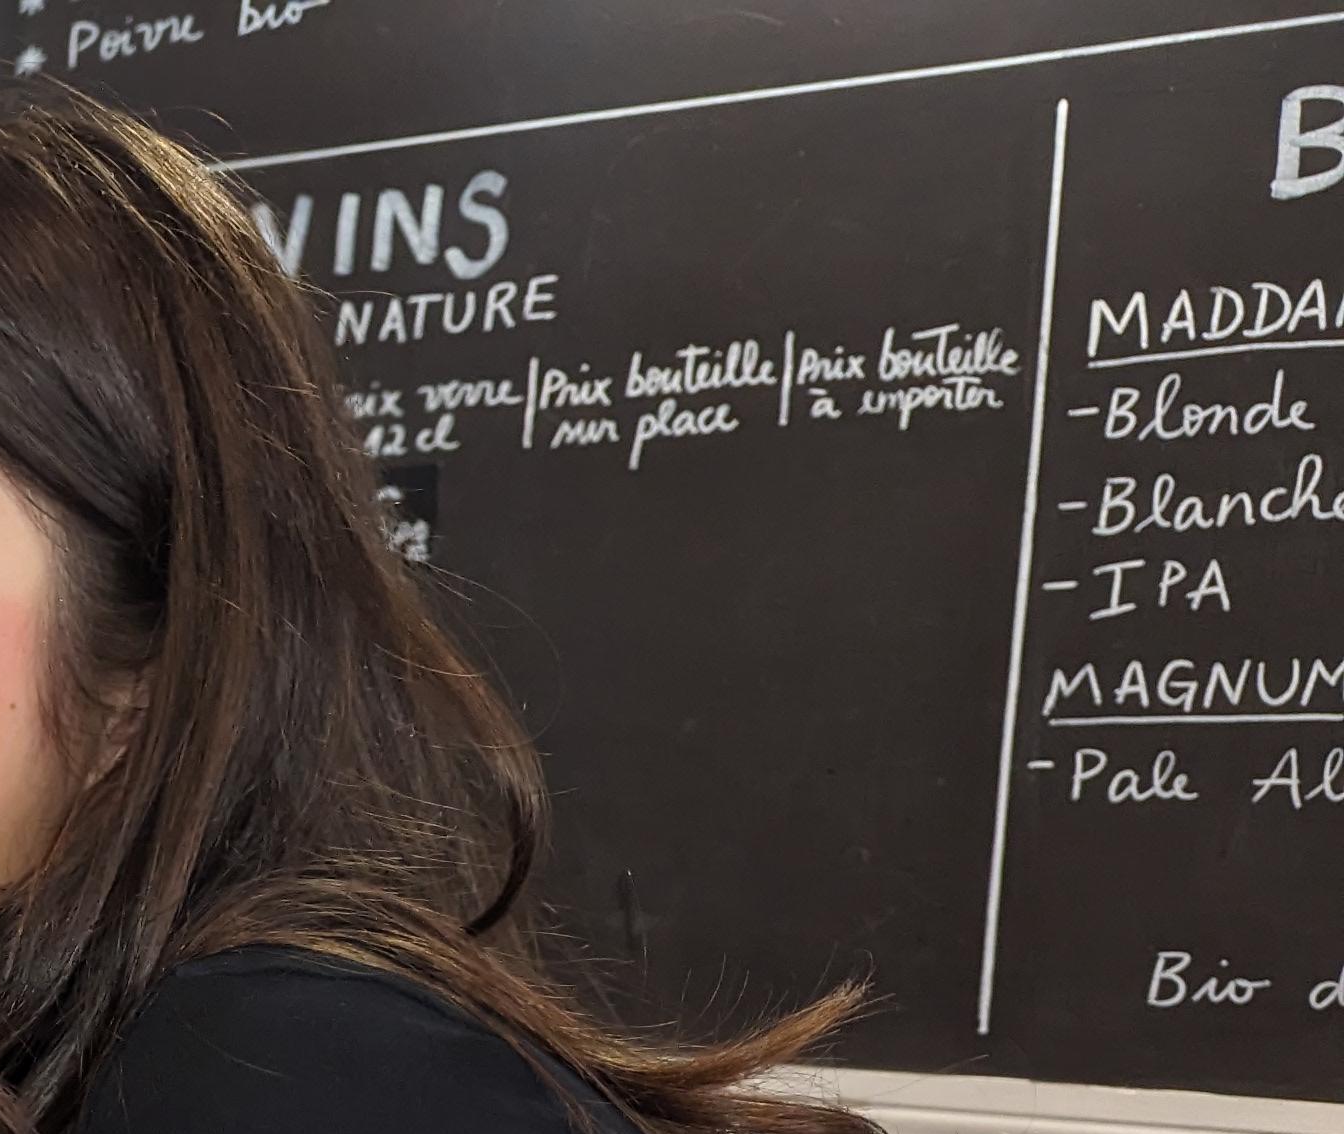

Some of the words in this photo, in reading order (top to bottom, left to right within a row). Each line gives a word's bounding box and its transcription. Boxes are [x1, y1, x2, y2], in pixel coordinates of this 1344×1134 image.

[66, 14, 204, 70] Poivre
[237, 0, 330, 36] bio
[1270, 84, 1344, 200] B
[250, 169, 509, 280] VINS
[334, 274, 559, 347] NATURE
[1086, 278, 1344, 359] MADDA
[540, 364, 612, 410] Prix
[626, 339, 777, 398] bouteille
[797, 345, 866, 386] Prix
[878, 324, 1022, 383] bouteille
[344, 380, 404, 419] rix
[417, 378, 525, 413] verre
[858, 374, 1005, 431] emporter
[550, 412, 619, 450] sur
[628, 400, 739, 471] place
[1042, 657, 1344, 716] MAGNUM
[1147, 951, 1272, 1008] Bio
